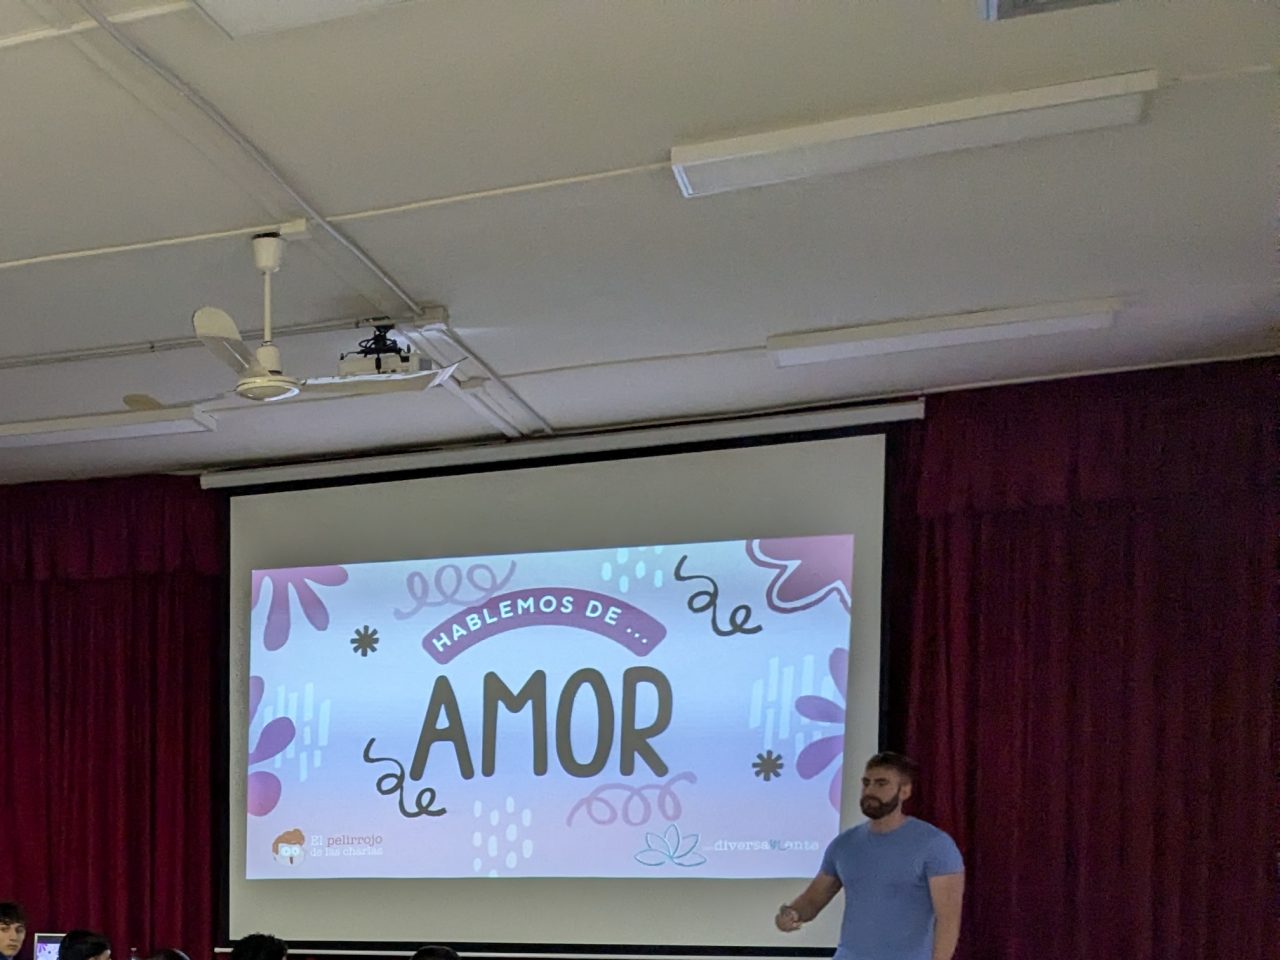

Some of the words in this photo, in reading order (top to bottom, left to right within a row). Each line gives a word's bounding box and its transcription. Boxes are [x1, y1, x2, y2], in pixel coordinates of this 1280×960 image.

[432, 595, 574, 652] HABLEMOS
[410, 666, 672, 781] AMOR
[327, 834, 383, 847] pelirrojo
